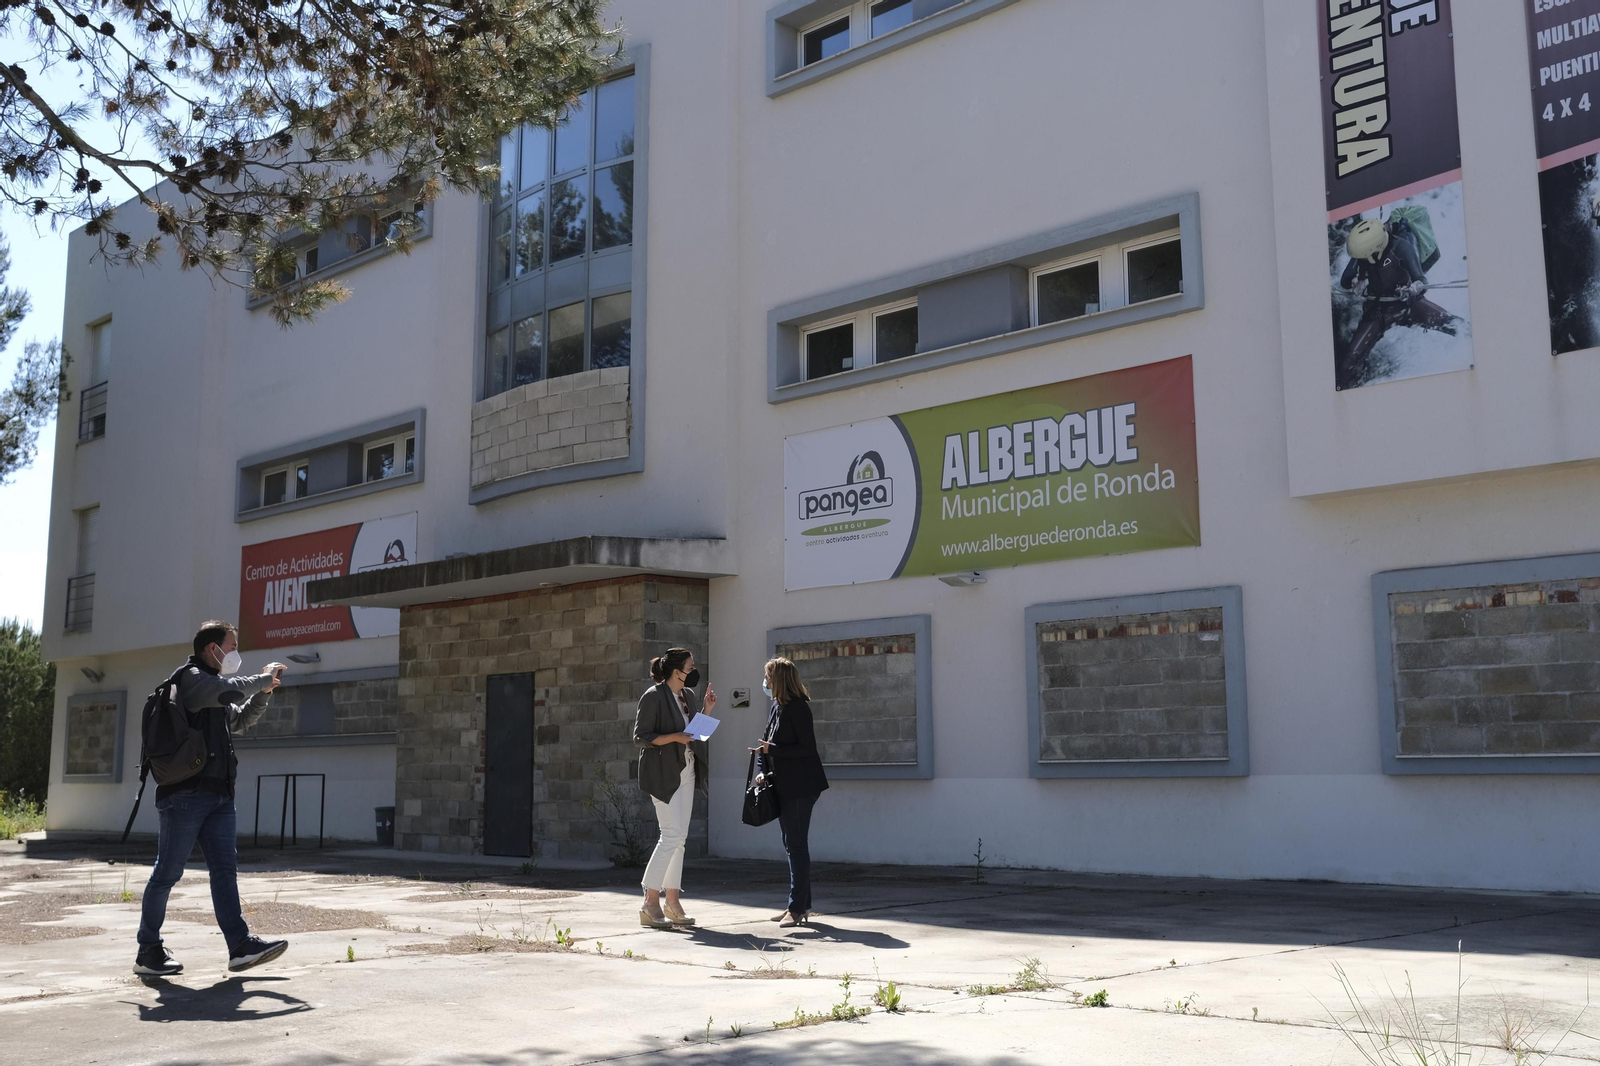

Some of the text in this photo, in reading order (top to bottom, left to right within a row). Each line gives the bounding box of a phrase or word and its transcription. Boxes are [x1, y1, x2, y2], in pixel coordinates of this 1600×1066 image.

[1389, 0, 1438, 36] E
[1534, 0, 1571, 14] ES
[1536, 12, 1600, 50] MULTIA
[1539, 50, 1600, 87] PUENTI
[1542, 92, 1591, 122] 4 X 4
[941, 402, 1138, 490] ALBERGUE
[804, 484, 887, 519] pangea
[942, 463, 1176, 520] Municipal de Ronda
[823, 521, 867, 533] ALBERGUE
[825, 533, 860, 544] actividades
[941, 519, 1138, 557] www.alberguederonda.es
[245, 549, 344, 581] Centro de Actividades
[263, 570, 340, 616] AVENT
[265, 620, 341, 639] www.pangeacentral.com
